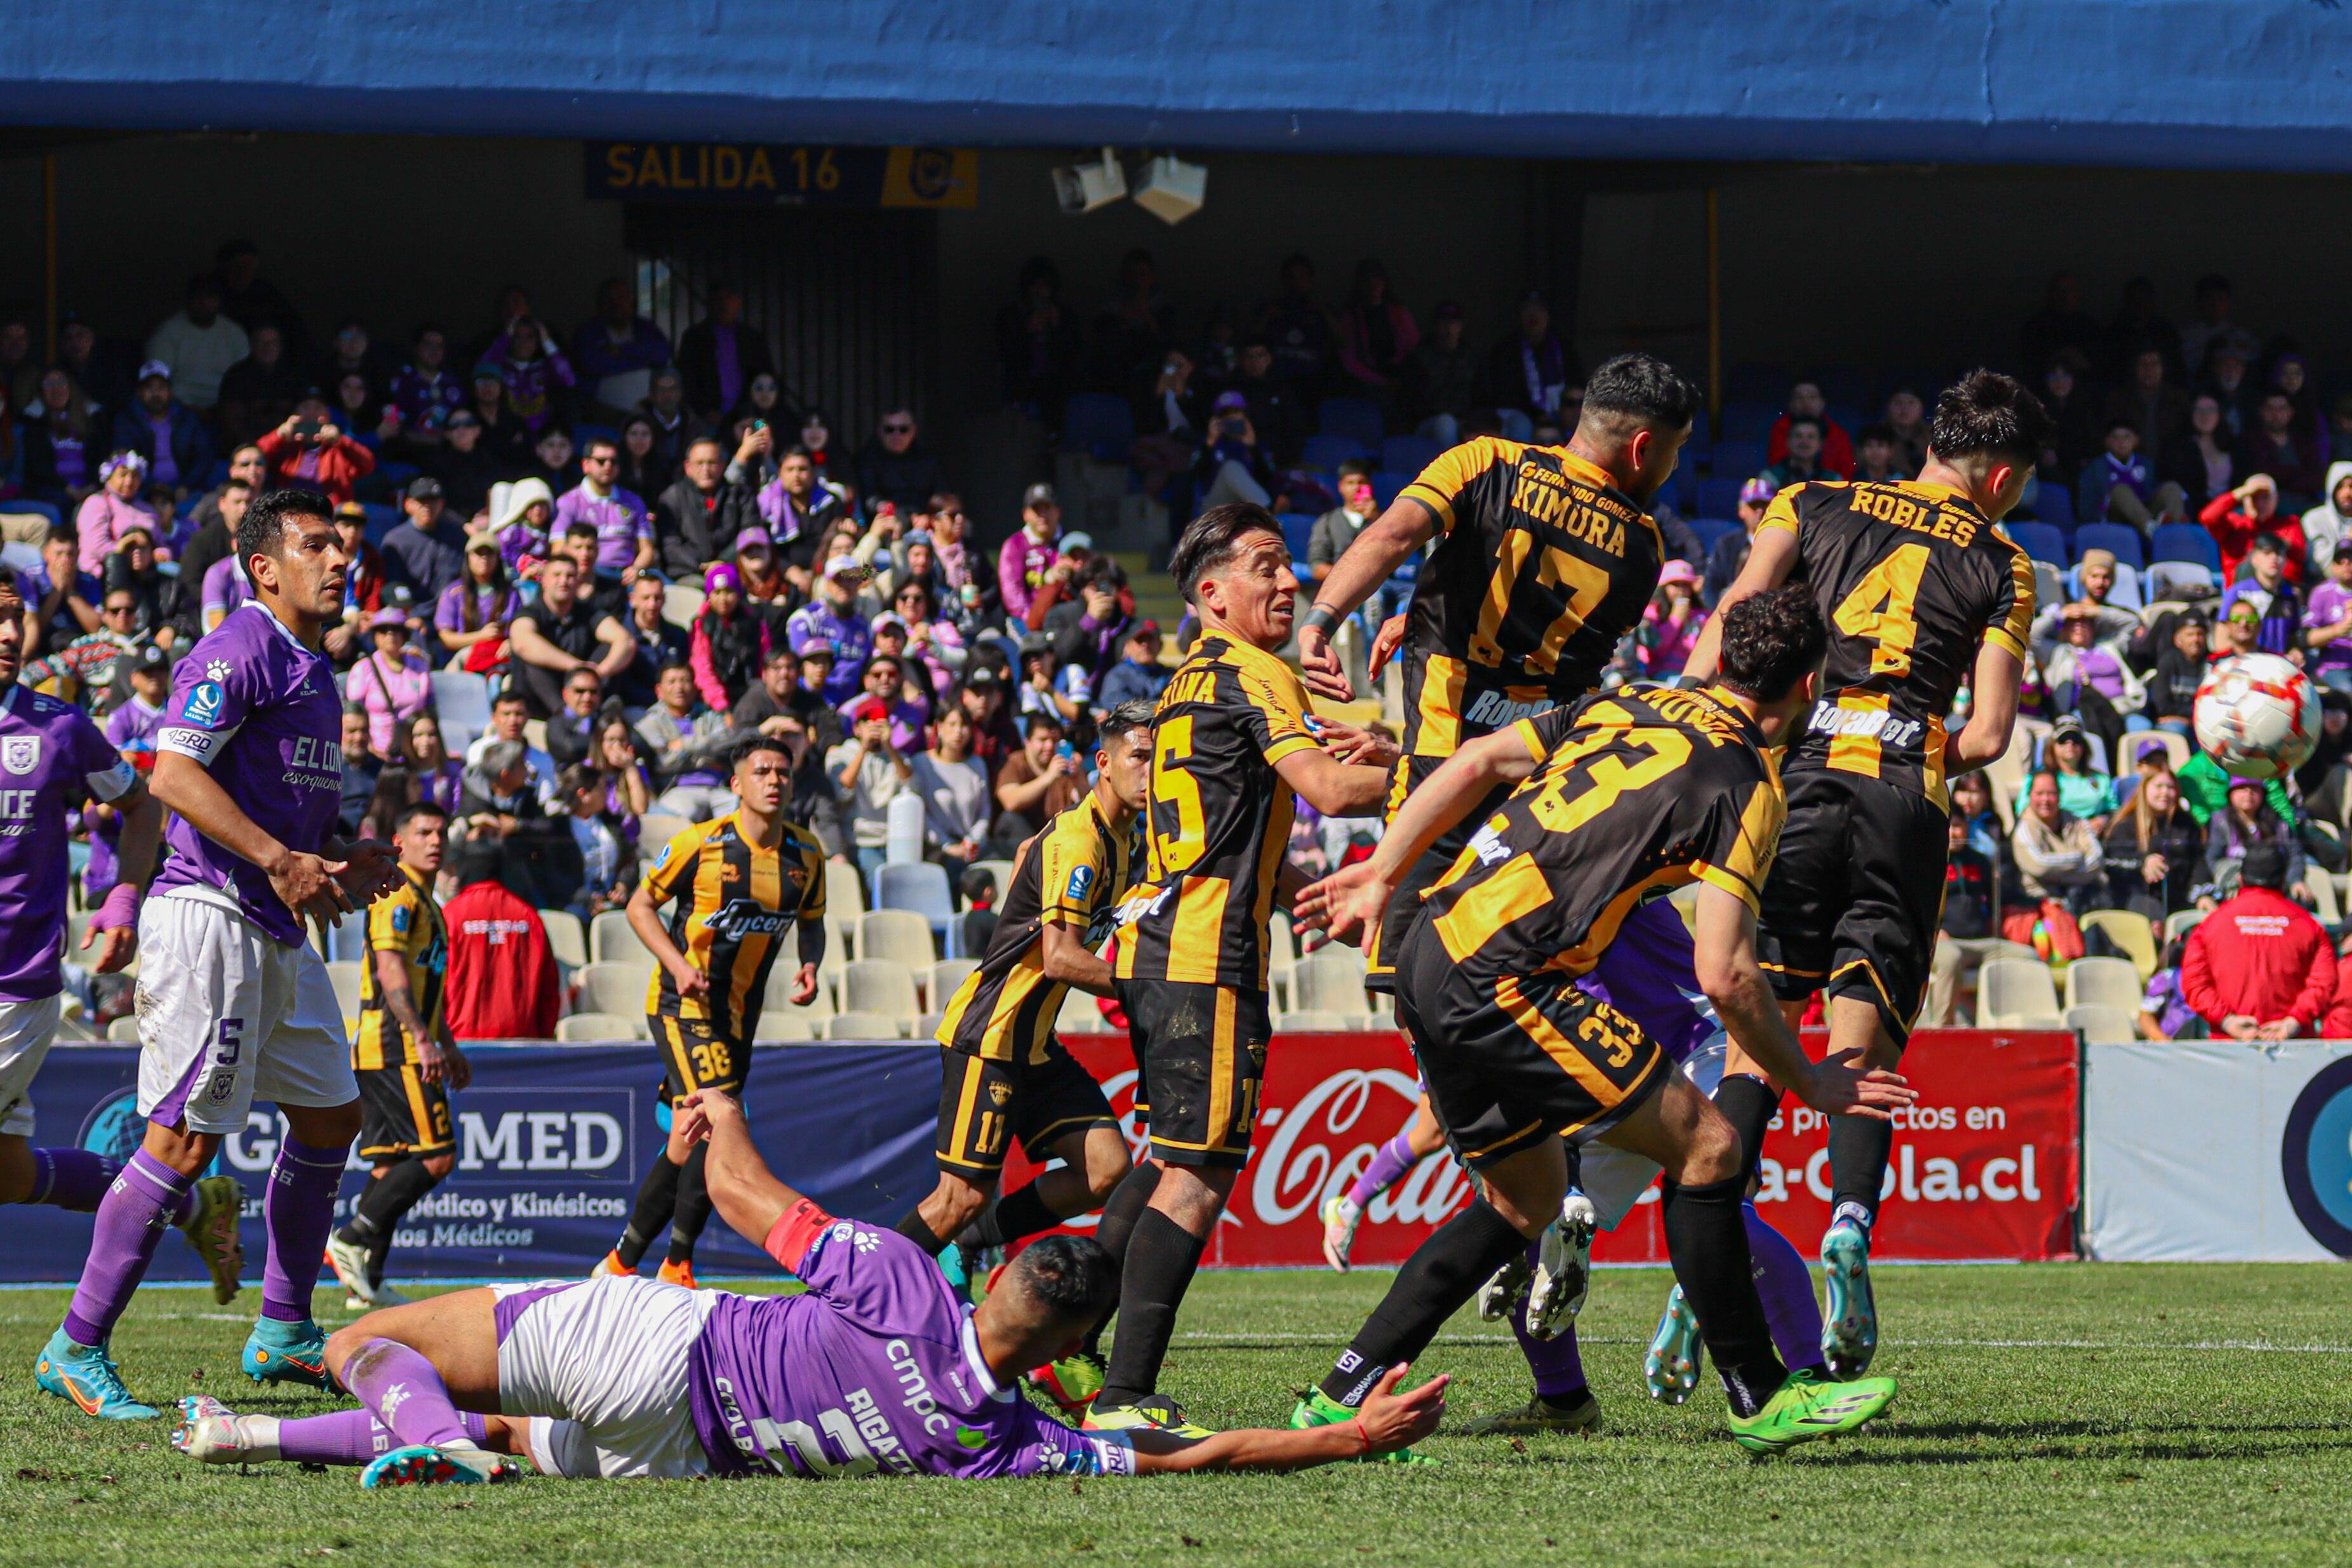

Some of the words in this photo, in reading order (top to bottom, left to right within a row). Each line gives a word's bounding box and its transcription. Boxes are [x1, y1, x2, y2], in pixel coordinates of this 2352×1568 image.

[608, 146, 776, 188] SALIDA
[791, 148, 840, 189] 16
[1511, 477, 1626, 558] KIMURA
[1848, 489, 1977, 548] ROBLES
[1467, 528, 1610, 675] 17
[1833, 543, 1931, 677] 4
[291, 736, 319, 769] EL
[217, 1018, 244, 1064] 5
[975, 1111, 1005, 1154] 11
[1793, 1105, 1957, 1136] prctos
[1966, 1107, 2006, 1131] en
[490, 1198, 507, 1223] y
[511, 1192, 627, 1218] Kinésicos
[431, 1223, 533, 1247] Médicos
[886, 1339, 950, 1436] cmpc
